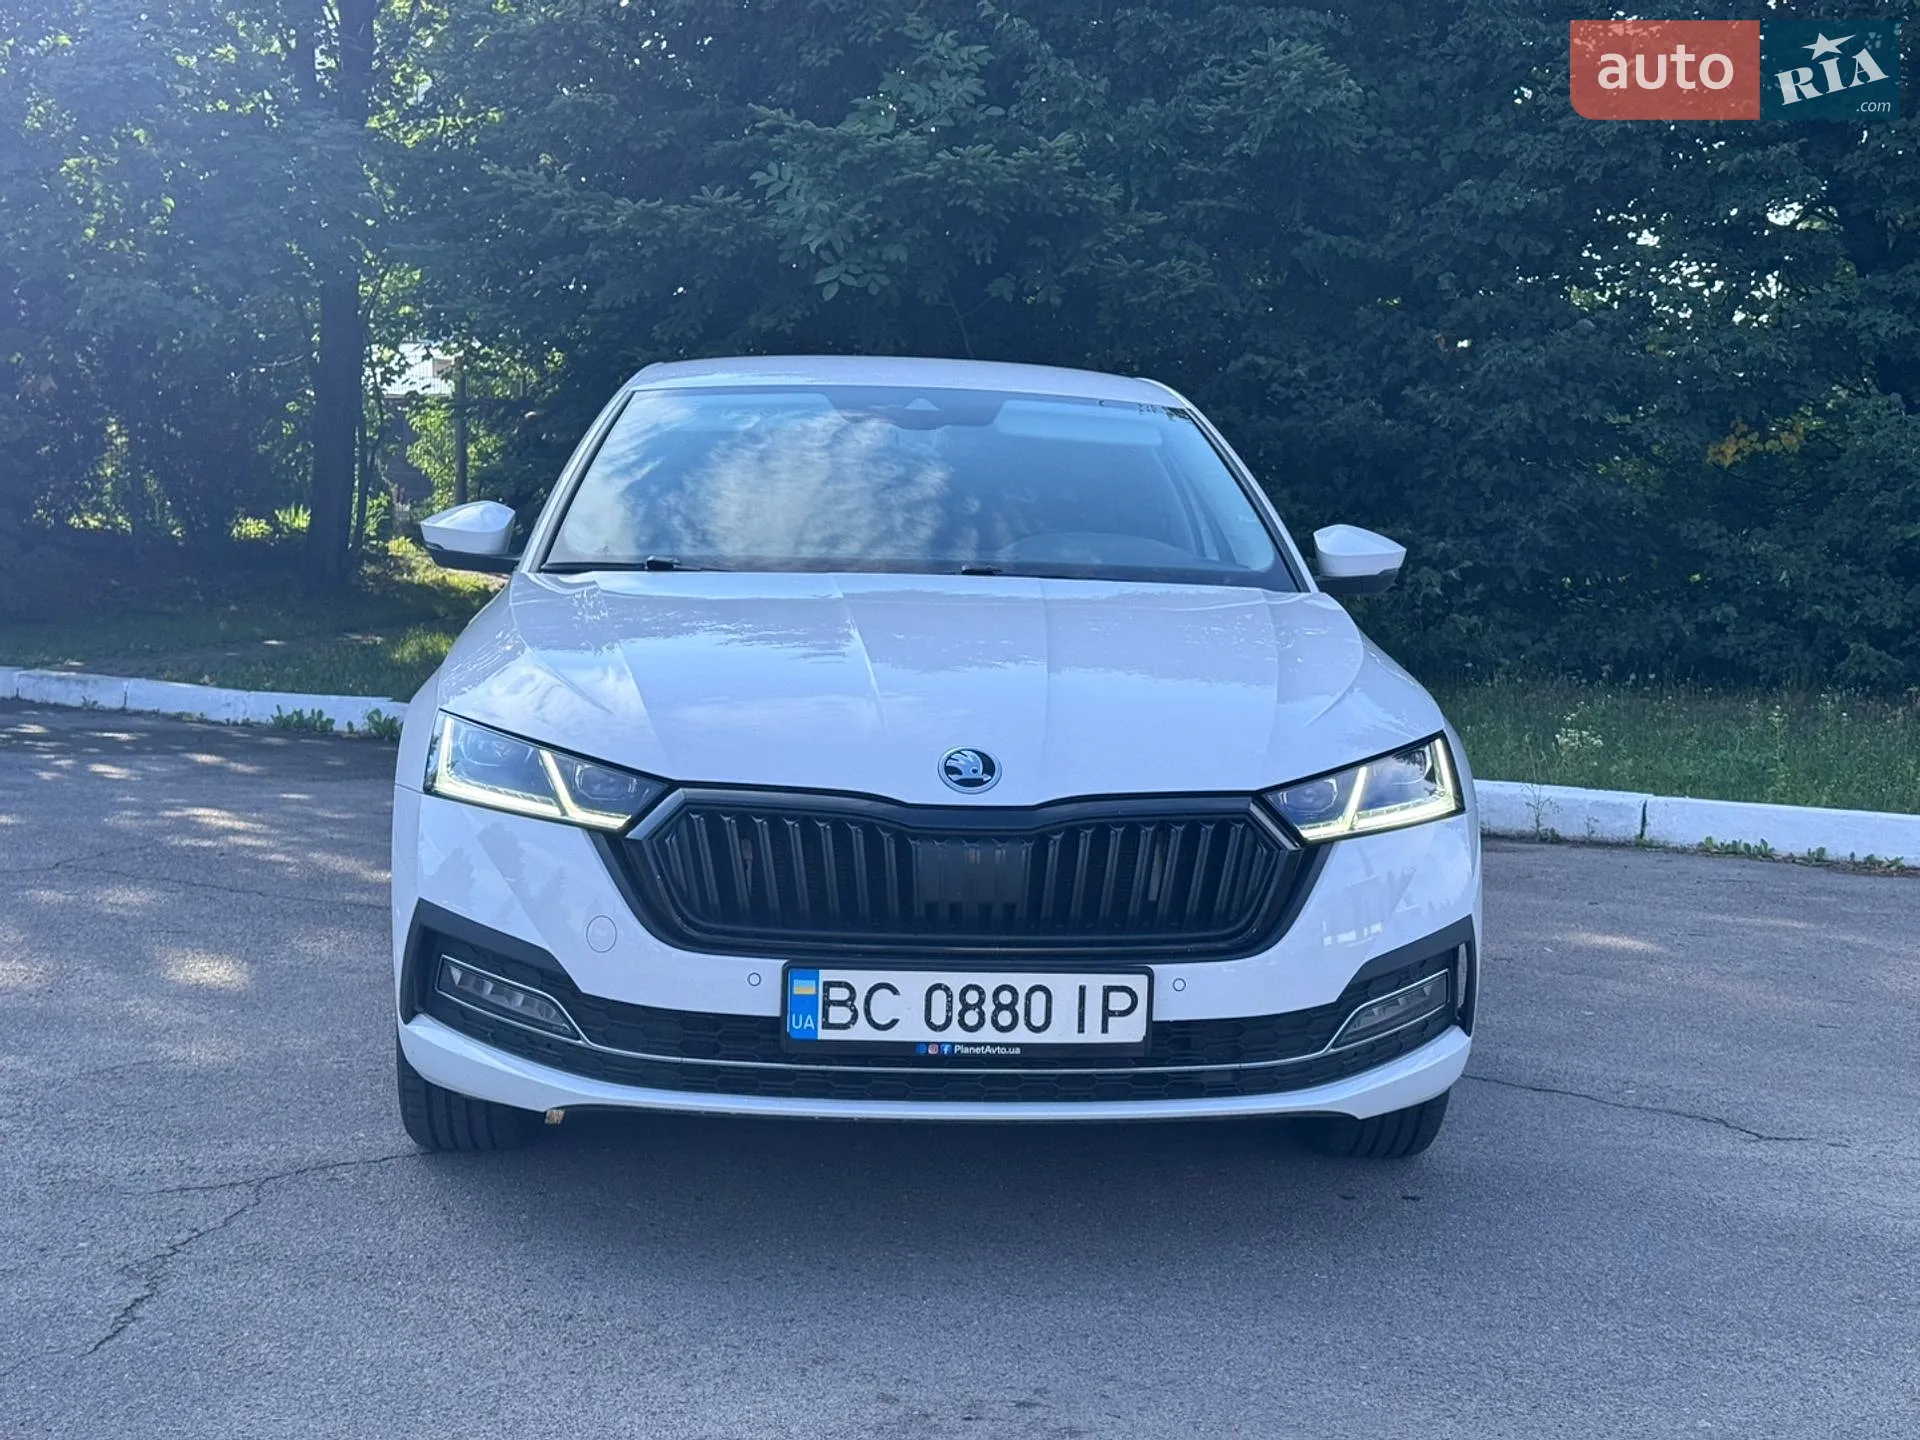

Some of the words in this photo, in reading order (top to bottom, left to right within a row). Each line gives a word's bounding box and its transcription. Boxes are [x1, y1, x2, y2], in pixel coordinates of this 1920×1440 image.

[821, 980, 901, 1032] BC
[924, 982, 1053, 1034] 0880
[1076, 984, 1139, 1035] IP
[792, 1016, 816, 1031] UA
[953, 1044, 1021, 1055] PlanetAvto.ua
